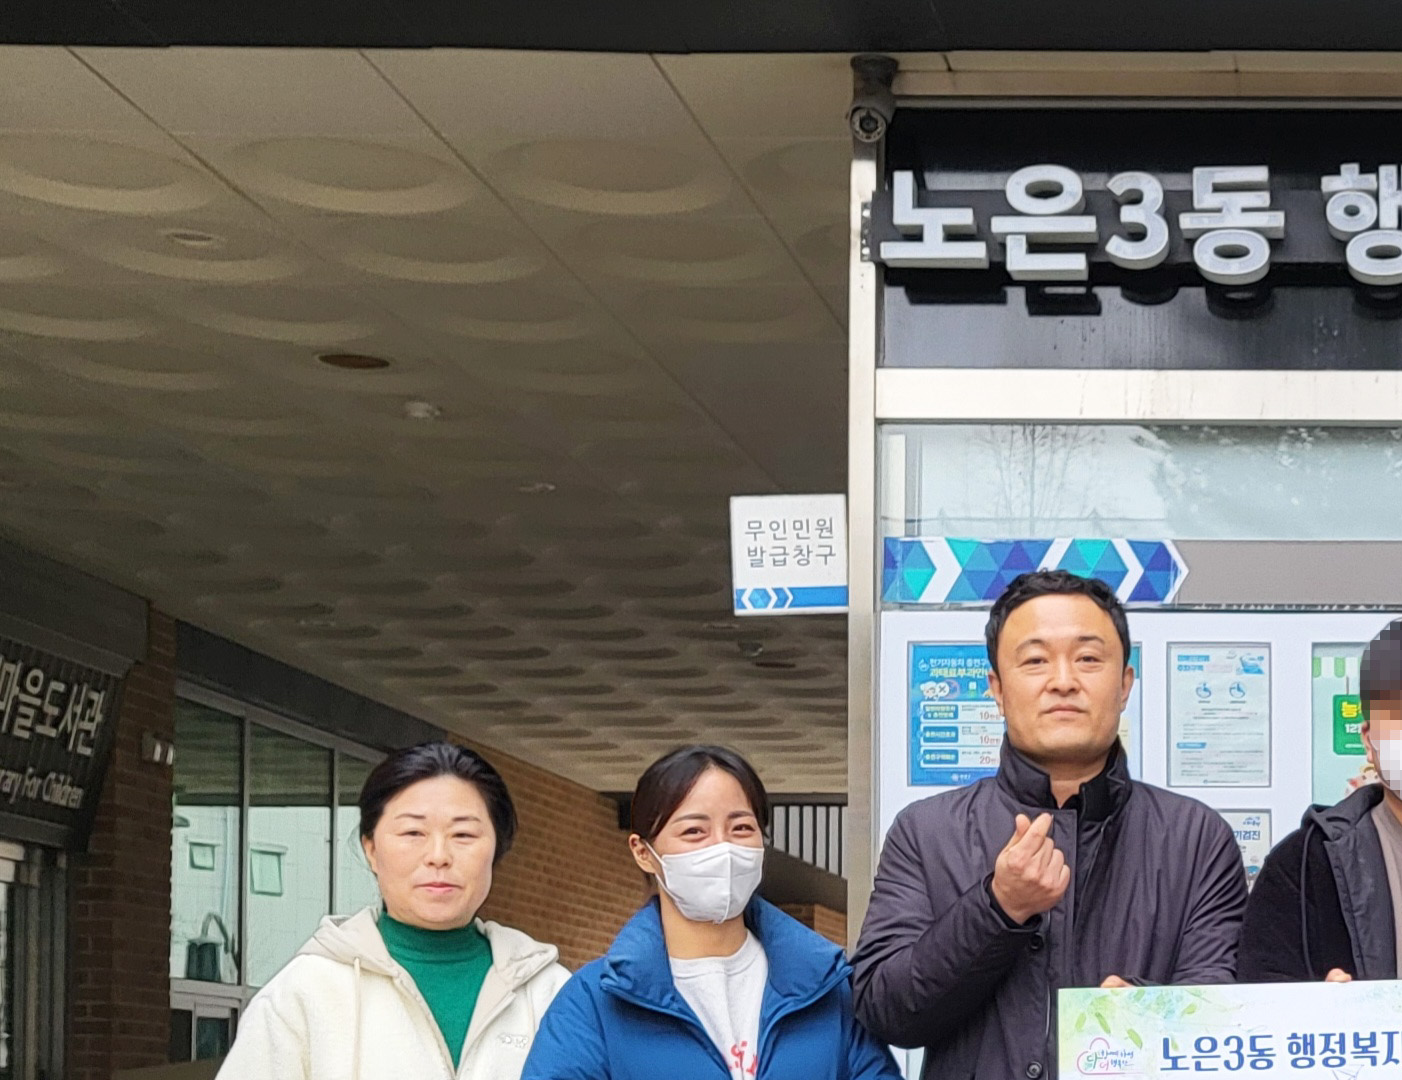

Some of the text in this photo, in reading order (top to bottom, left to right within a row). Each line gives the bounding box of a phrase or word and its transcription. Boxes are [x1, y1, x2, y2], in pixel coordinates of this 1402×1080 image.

[880, 164, 1286, 283] 노은3동
[744, 517, 834, 541] 무인민원
[747, 544, 836, 568] 발급창구
[0, 654, 106, 757] 마을도서관
[1160, 1034, 1277, 1071] 노은3동
